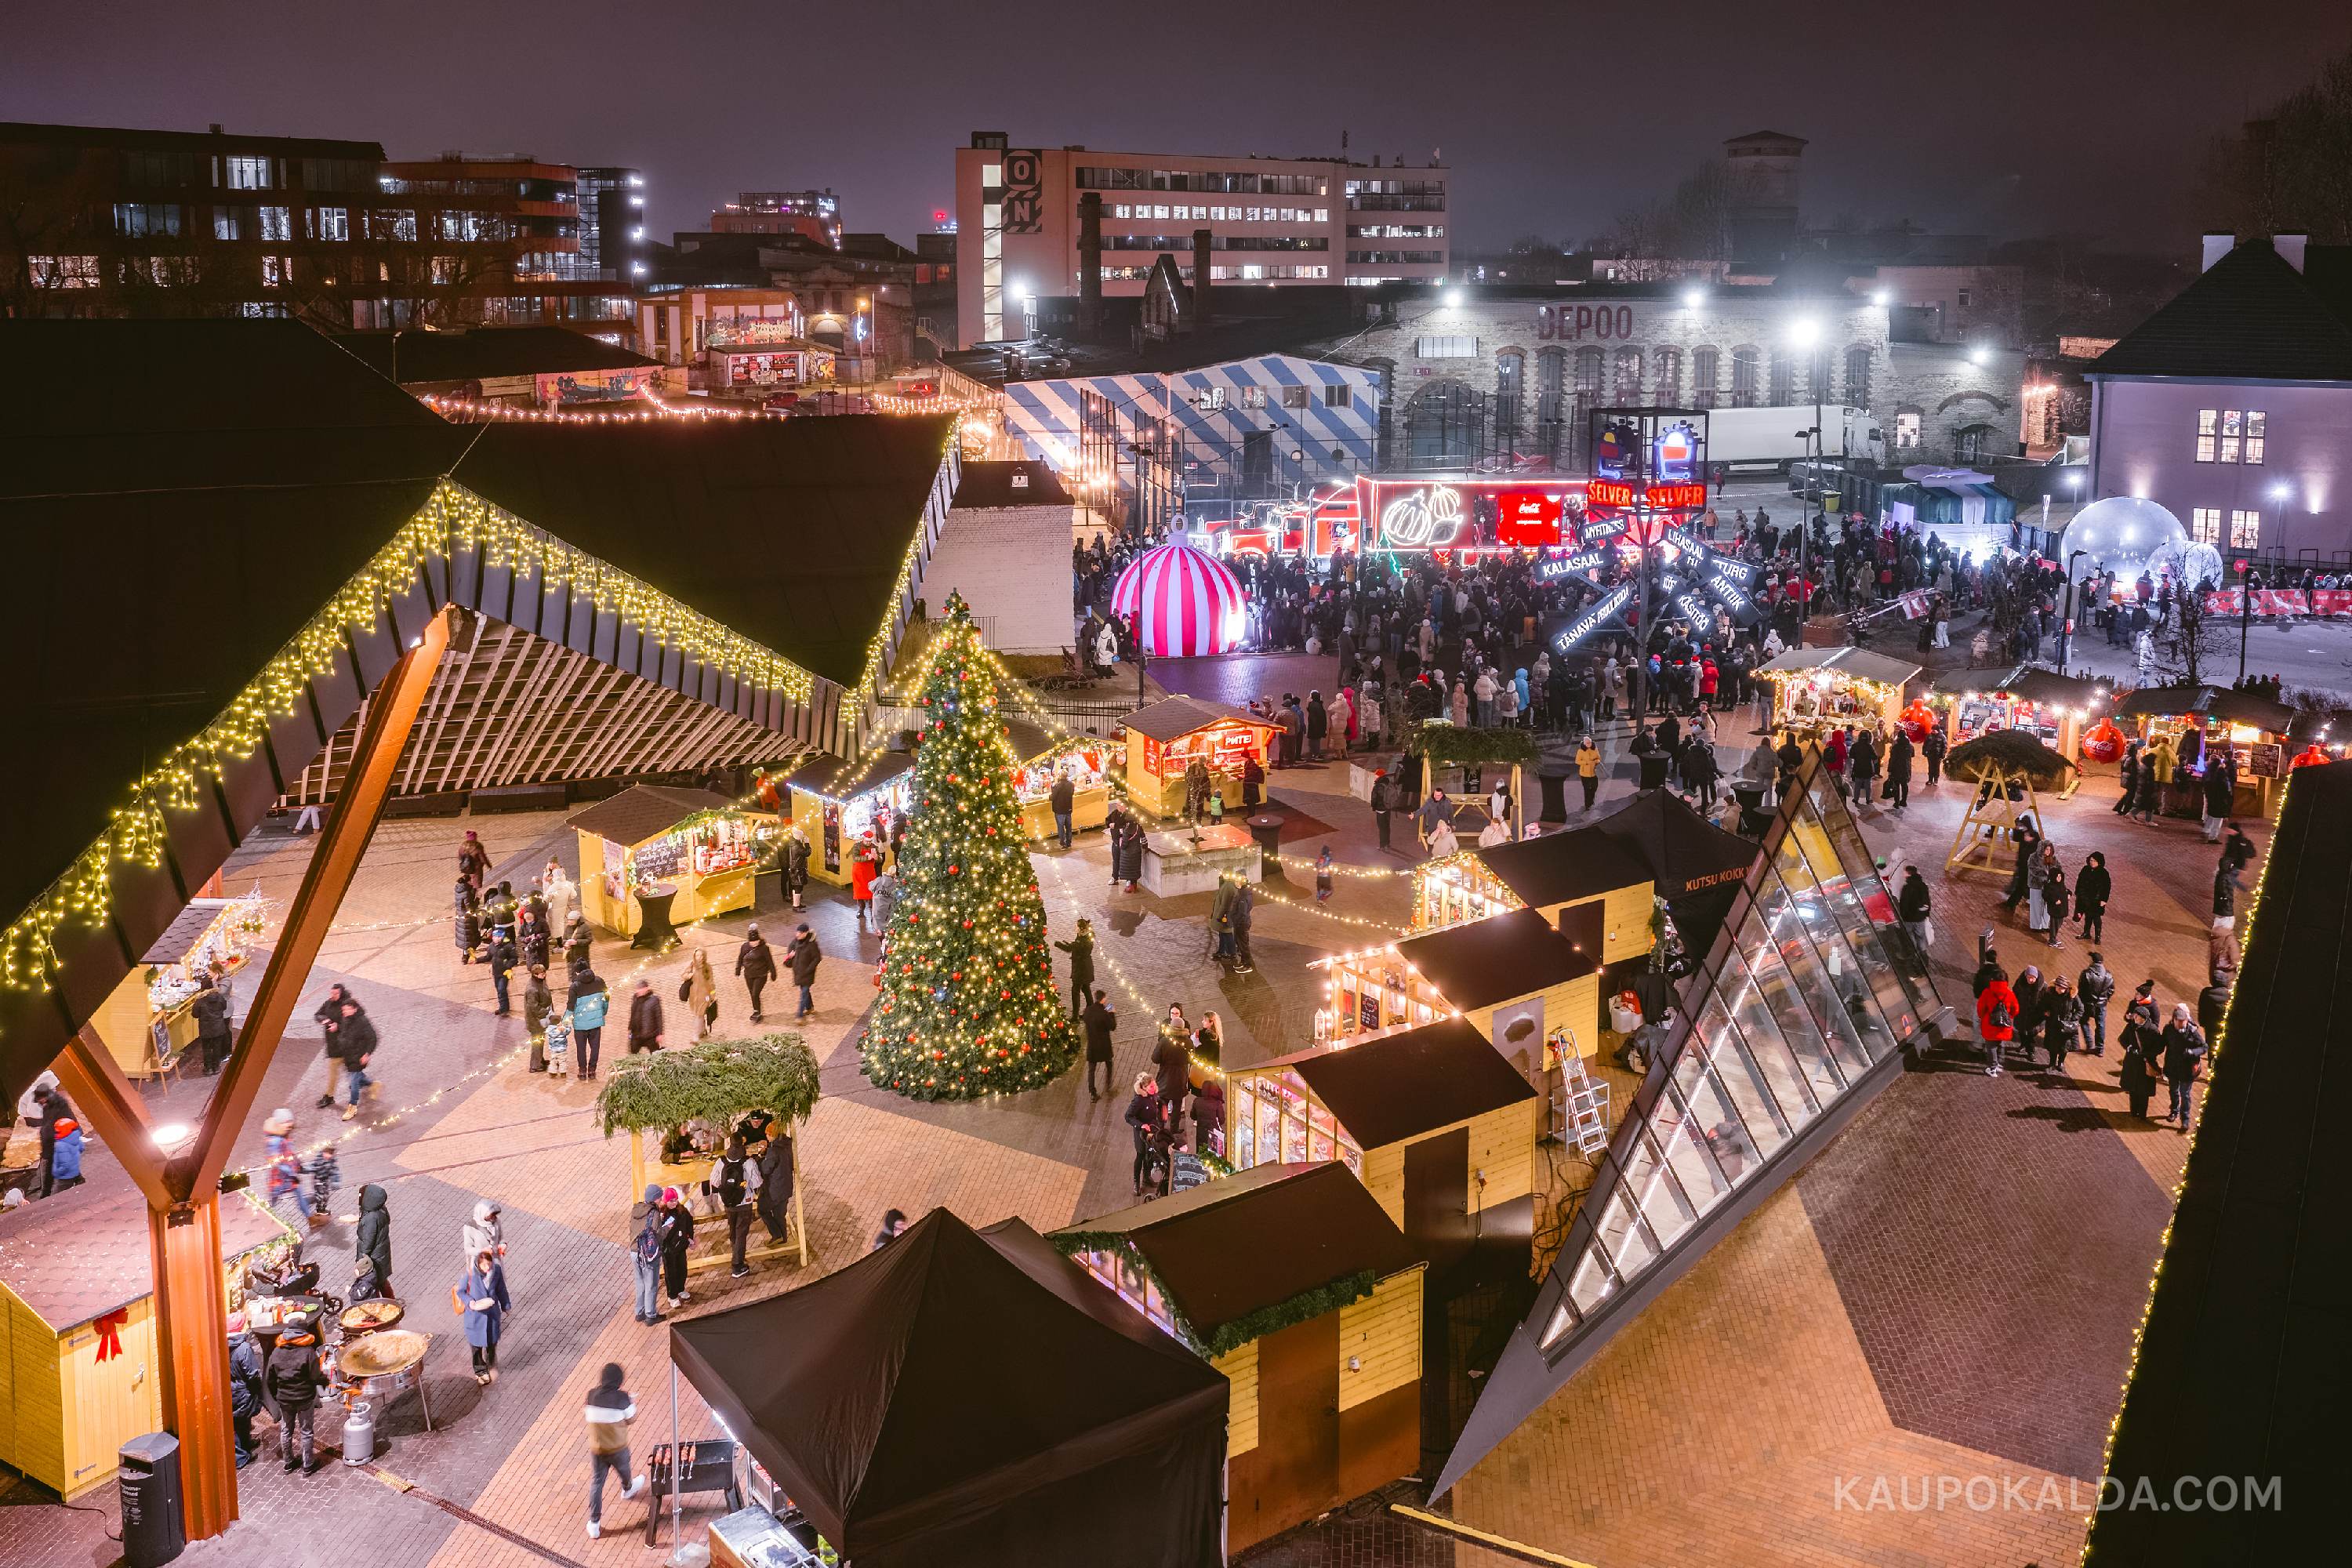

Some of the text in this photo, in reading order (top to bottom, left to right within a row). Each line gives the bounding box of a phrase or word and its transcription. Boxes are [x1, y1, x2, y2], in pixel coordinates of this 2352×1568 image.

[1539, 305, 1632, 339] DEPOO
[1588, 483, 1632, 506] SELVER
[1647, 485, 1704, 507] SELVER
[1668, 528, 1704, 561] LIHASAAL
[1543, 553, 1604, 577] KALASAAL
[1710, 575, 1745, 612] ANTIIK
[1678, 594, 1711, 632] KÄSITÖÖ
[1686, 873, 1719, 891] KUTSU
[1719, 867, 1744, 883] KOKK
